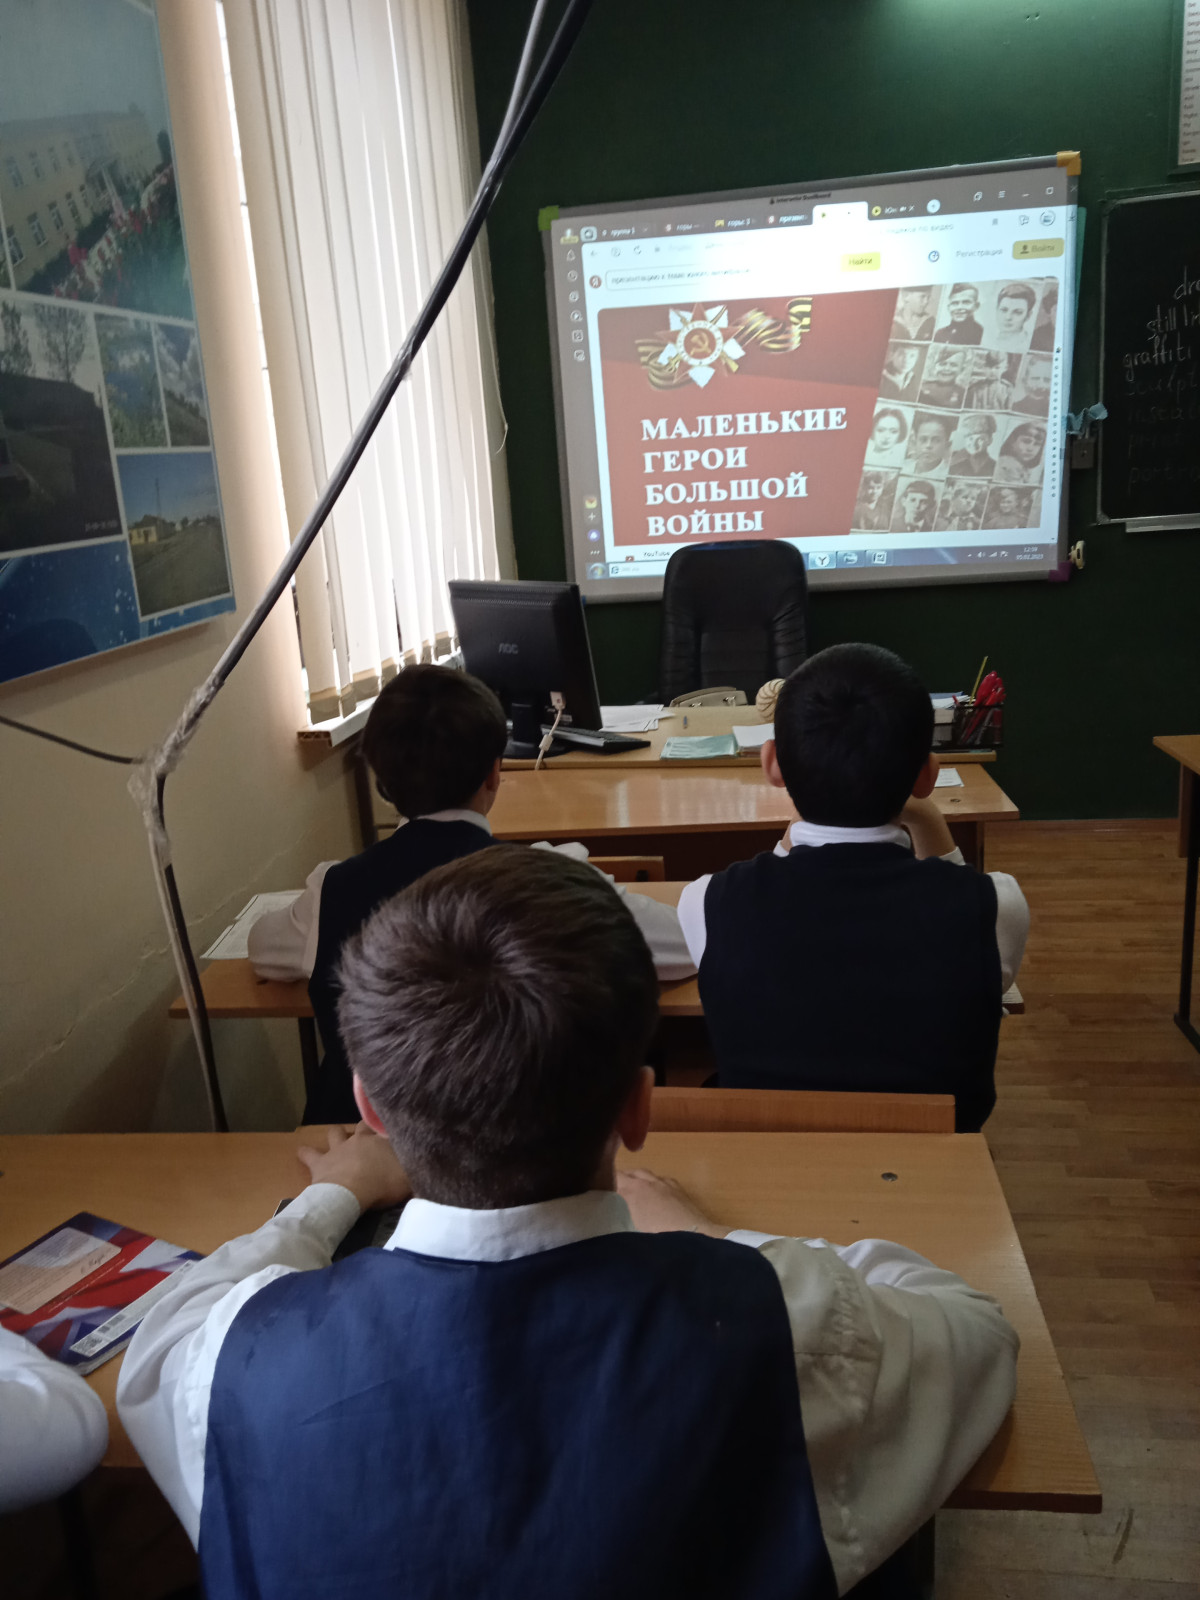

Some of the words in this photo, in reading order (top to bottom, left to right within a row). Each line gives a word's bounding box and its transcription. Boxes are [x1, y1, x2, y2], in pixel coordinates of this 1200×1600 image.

[1122, 331, 1191, 382] graffiti
[641, 407, 848, 440] МАЛЕНЬКИЕ
[643, 446, 748, 473] ГЕРОИ
[645, 471, 808, 505] БОЛЬШОЙ
[646, 508, 764, 536] ВОЙНЫ
